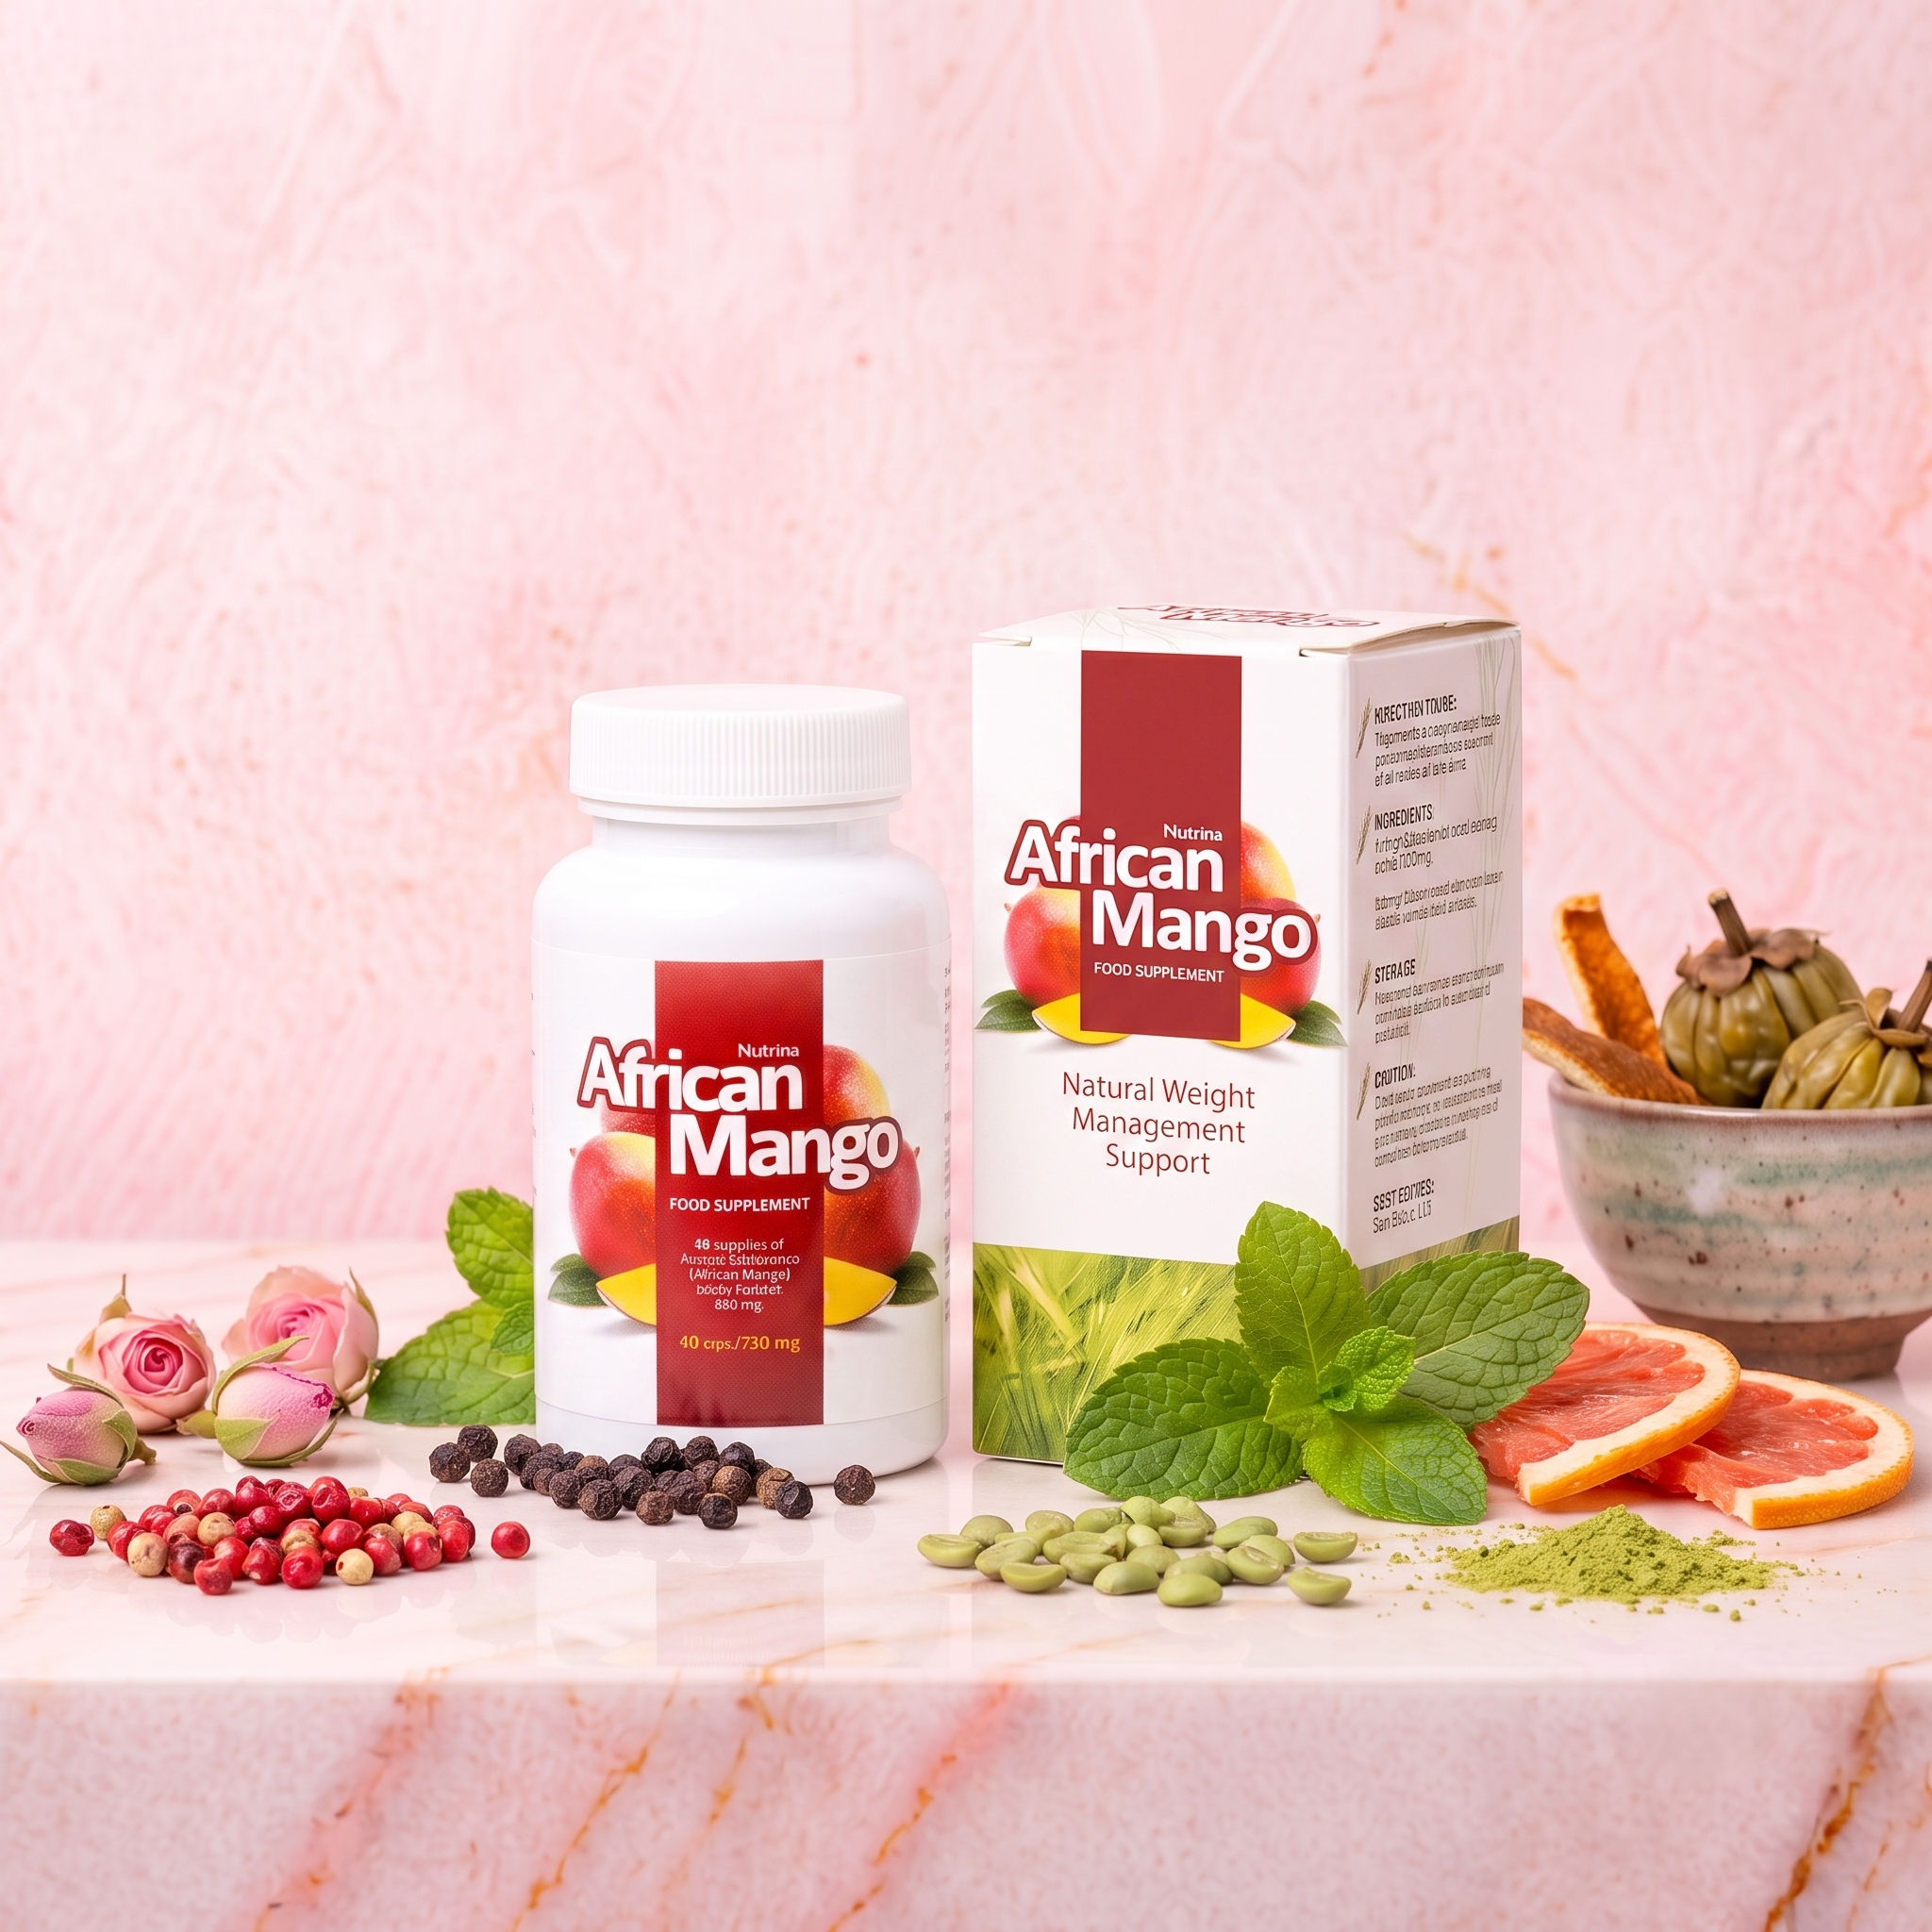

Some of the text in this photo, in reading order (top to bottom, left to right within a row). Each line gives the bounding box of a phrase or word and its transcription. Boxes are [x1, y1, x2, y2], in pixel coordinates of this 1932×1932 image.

[1163, 824, 1223, 841] Nutrina
[1007, 822, 1224, 893] African
[1091, 889, 1314, 974] Mango
[1093, 961, 1224, 983] FOOD SUPPLEMENT
[738, 1043, 800, 1058] Nutrina
[578, 1039, 803, 1111] African
[1062, 1072, 1256, 1113] Natural Weight
[1073, 1108, 1245, 1143] Management
[669, 1114, 902, 1191] Mango
[1106, 1143, 1210, 1177] Support
[669, 1197, 810, 1212] FOOD SUPPLEMENT
[713, 1239, 768, 1253] supplies
[771, 1238, 784, 1250] of
[742, 1268, 791, 1283] Mange)
[714, 1299, 764, 1313] 880 mg.
[679, 1335, 700, 1349] 40
[774, 1338, 801, 1354] mg
